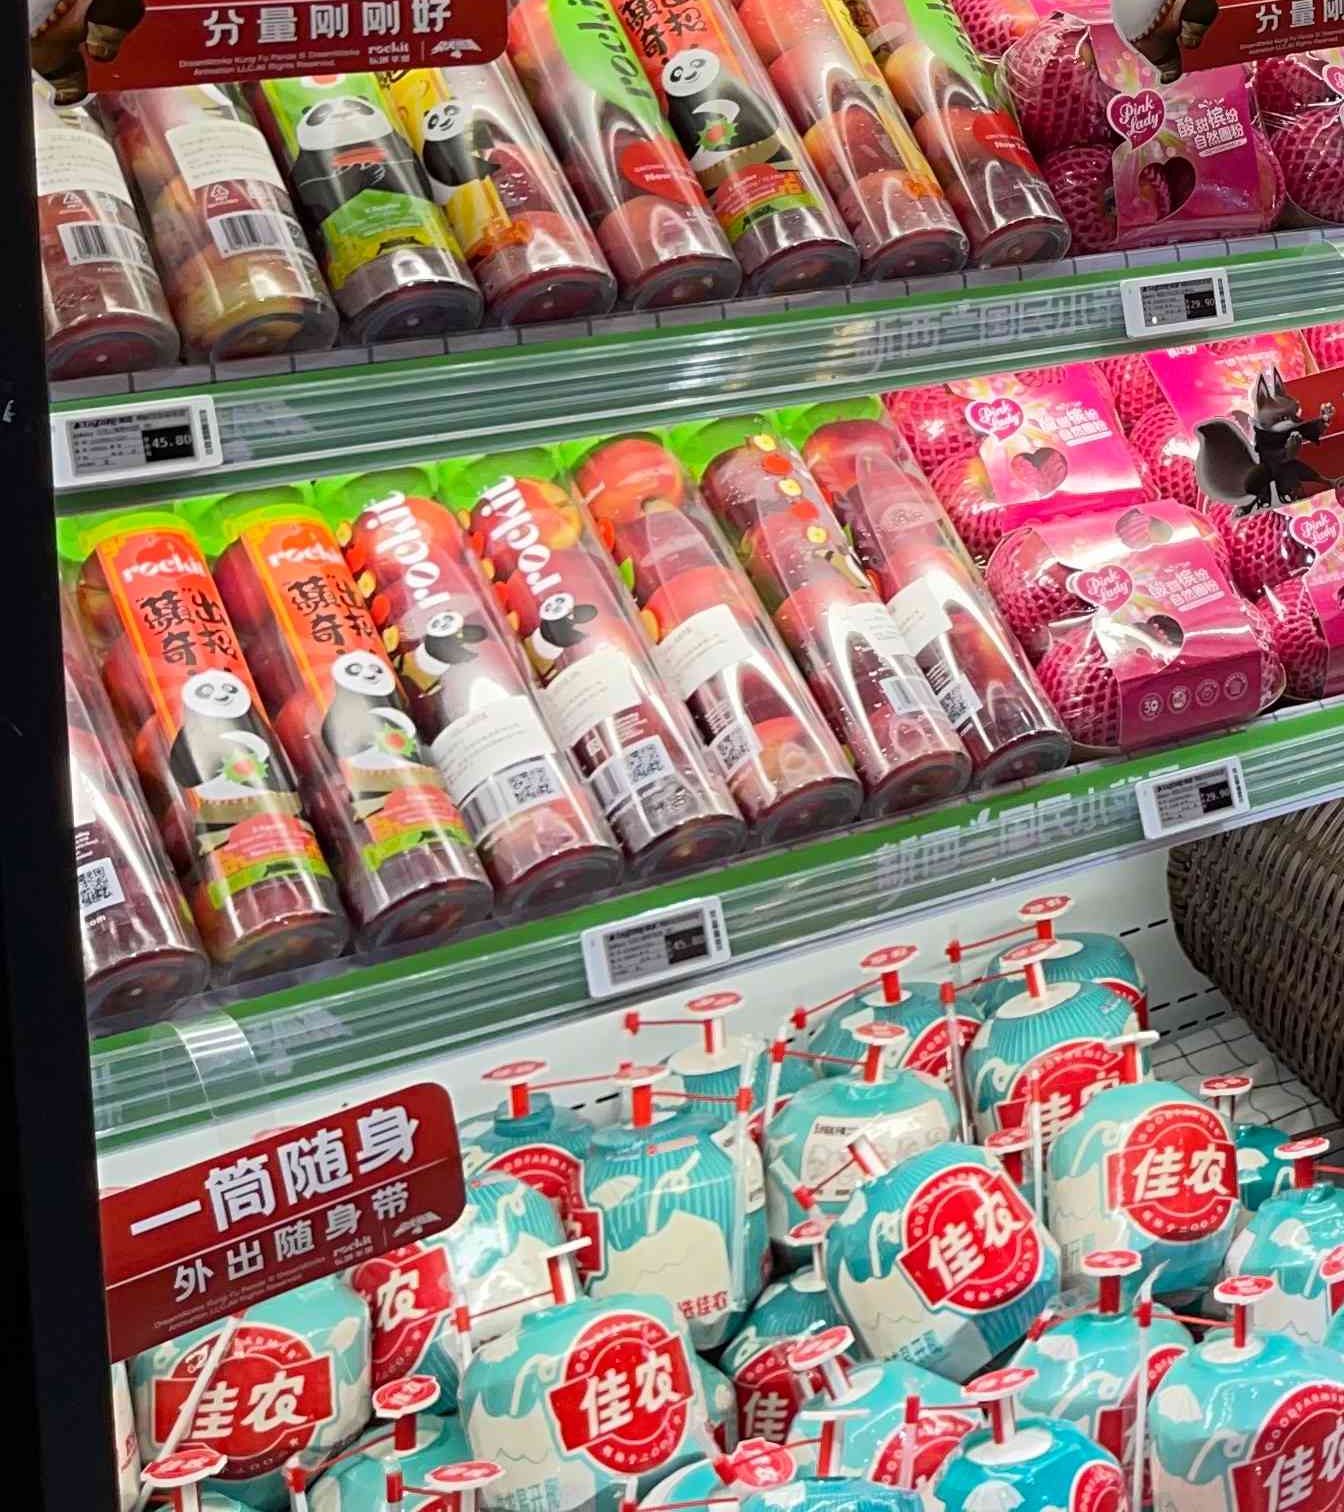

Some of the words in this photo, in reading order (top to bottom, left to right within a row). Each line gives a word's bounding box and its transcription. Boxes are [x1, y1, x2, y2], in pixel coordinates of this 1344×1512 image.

[1119, 95, 1154, 125] Pink
[1127, 112, 1160, 134] Lady
[152, 434, 193, 449] 45.80
[477, 475, 562, 595] rockit
[1302, 512, 1328, 537] Pink
[1312, 525, 1338, 546] Lady
[363, 489, 451, 609] rockit
[1087, 570, 1120, 596] Pink
[1101, 582, 1129, 603] Lady
[130, 1105, 419, 1236] 一筒随身
[1131, 1143, 1233, 1203] 佳农
[173, 1181, 409, 1303] 外出随身带
[928, 1191, 1024, 1289] 佳农
[580, 1349, 684, 1439] 佳农
